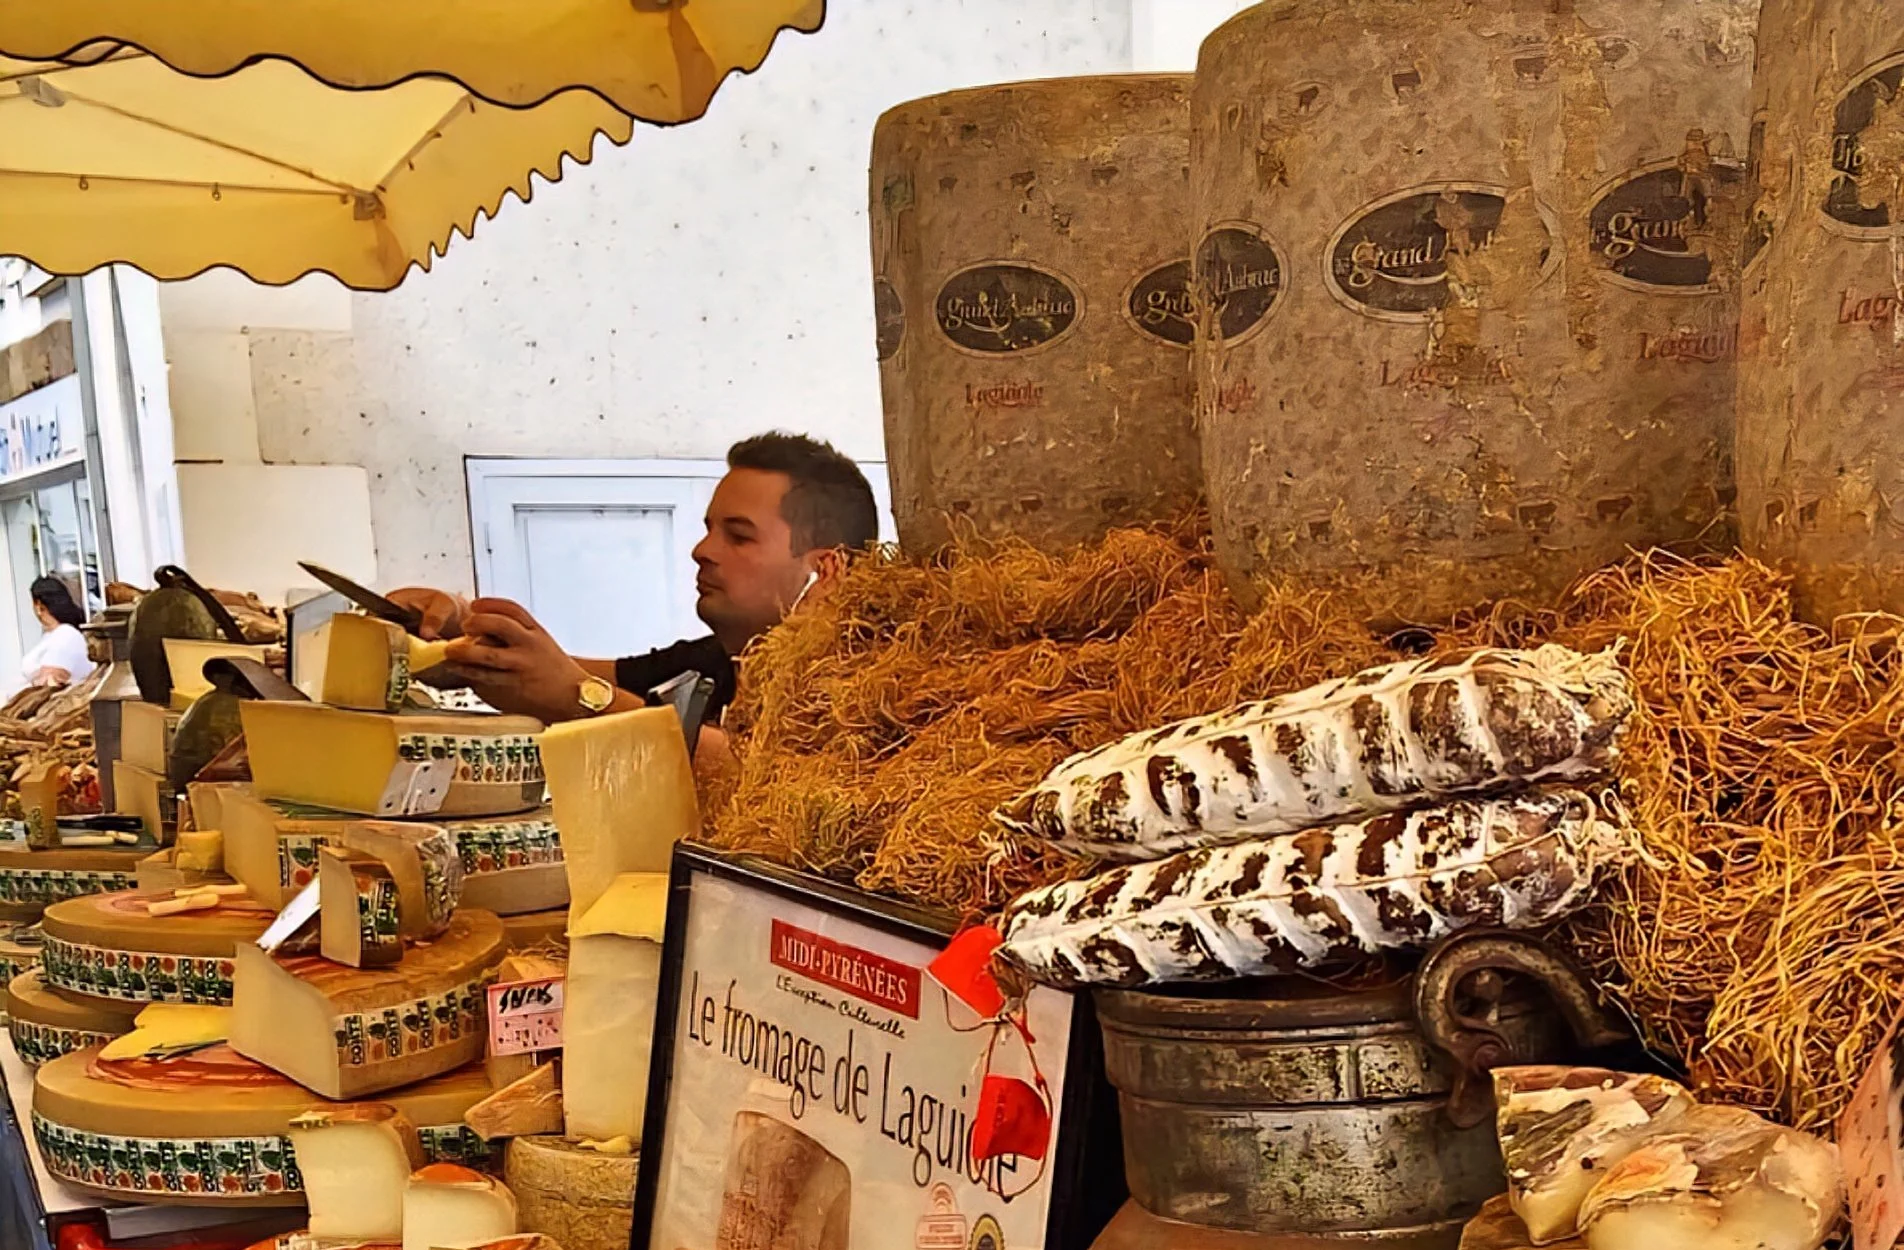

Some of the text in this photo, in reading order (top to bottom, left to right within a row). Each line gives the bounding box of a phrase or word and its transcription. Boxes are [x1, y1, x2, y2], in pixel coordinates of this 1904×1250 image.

[688, 970, 714, 1046] Le
[722, 979, 827, 1120] fromage
[834, 1028, 869, 1124] de
